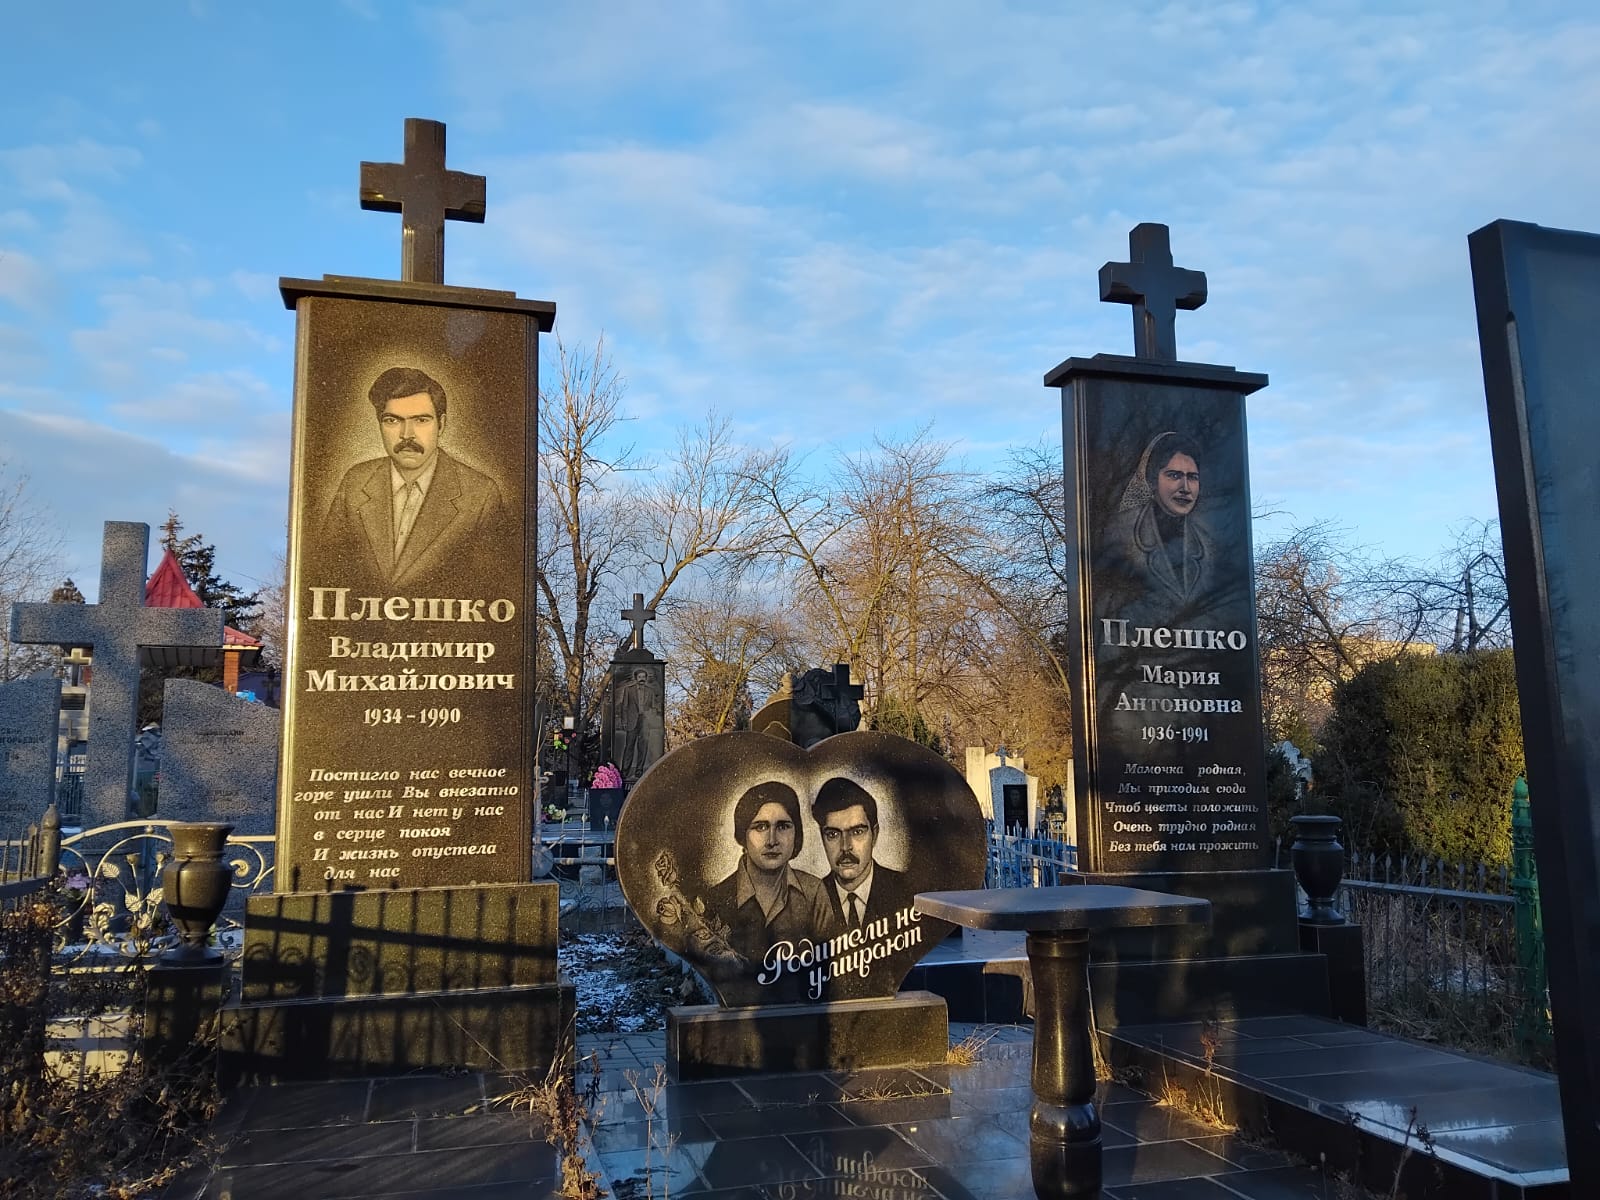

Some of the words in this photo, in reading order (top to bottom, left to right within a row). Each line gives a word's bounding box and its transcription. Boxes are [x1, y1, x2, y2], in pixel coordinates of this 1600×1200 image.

[308, 586, 516, 623] Плешко
[1102, 619, 1247, 650] Плешко
[328, 636, 496, 663] Владимир
[305, 669, 515, 692] Михайлович
[1141, 664, 1221, 688] Мария
[1114, 692, 1243, 713] Антоновна
[1141, 725, 1209, 744] 1936-1991
[309, 769, 400, 782] Постигло
[409, 769, 440, 780] нас
[448, 767, 506, 779] вечное
[1124, 763, 1184, 775] Мамочка
[294, 790, 334, 802] горе
[343, 789, 392, 803] ушли
[402, 786, 430, 799] Вы
[438, 785, 519, 798] внезапно
[1118, 783, 1142, 794] Мы
[1148, 783, 1211, 796] приходим
[1216, 783, 1247, 794] сюда
[314, 811, 342, 820] от
[353, 809, 384, 819] нас
[387, 805, 404, 819] И
[474, 806, 504, 816] нас
[1105, 802, 1141, 813] Чтоб
[1144, 804, 1188, 814] цветы
[1192, 804, 1260, 814] положить
[313, 830, 325, 841] в
[336, 829, 386, 843] серце
[399, 827, 451, 839] покоя
[1113, 821, 1153, 832] Очень
[1157, 820, 1207, 835] трудно
[1211, 820, 1257, 834] родная
[312, 848, 330, 861] И
[339, 849, 400, 861] жизнь
[411, 844, 498, 859] опустела
[1109, 841, 1131, 852] Без
[1134, 840, 1167, 852] тебя
[1170, 841, 1196, 851] нам
[1199, 841, 1260, 853] прожить
[324, 866, 356, 880] для
[369, 867, 401, 879] нас
[757, 917, 889, 985] Родители
[896, 906, 922, 930] не
[808, 926, 923, 1000] умирают
